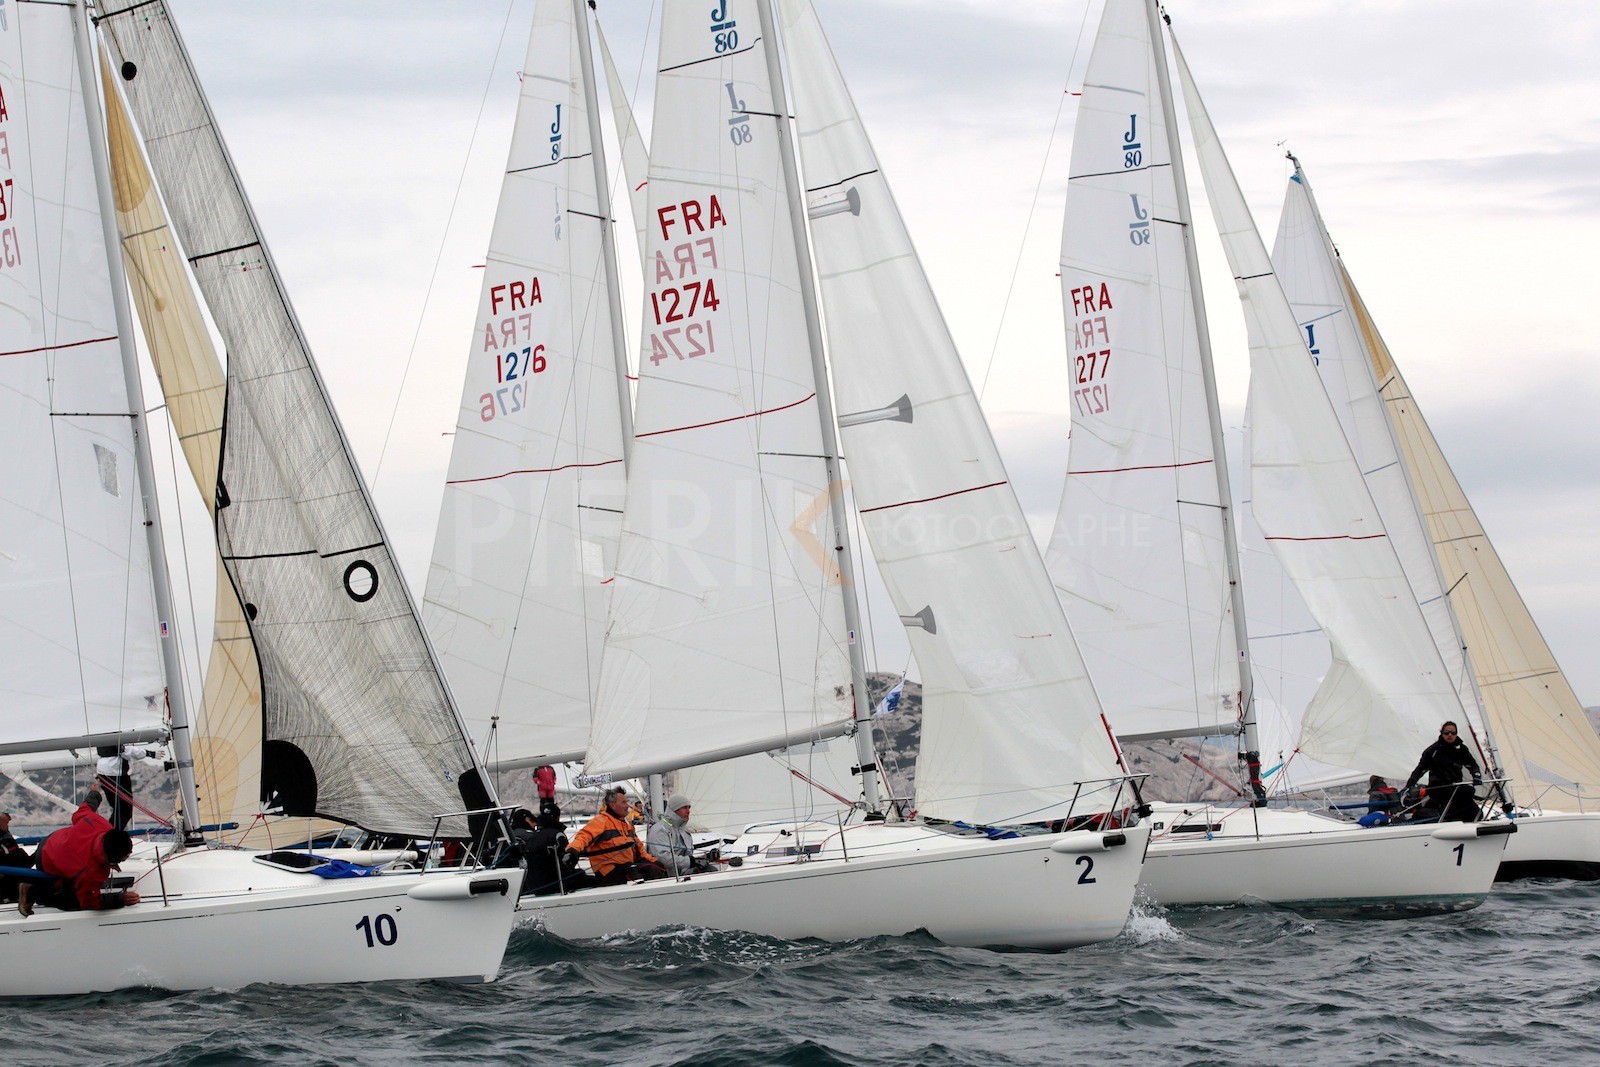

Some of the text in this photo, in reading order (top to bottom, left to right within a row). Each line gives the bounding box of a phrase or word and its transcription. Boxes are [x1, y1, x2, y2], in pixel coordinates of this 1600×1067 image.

[711, 0, 726, 22] J
[715, 30, 738, 53] 80
[551, 104, 561, 134] J
[1124, 114, 1137, 143] J
[552, 142, 562, 161] 8
[1124, 150, 1142, 168] 80
[657, 194, 727, 241] FRA
[490, 277, 542, 315] FRA
[651, 278, 720, 325] 1274
[1071, 282, 1113, 316] FRA
[497, 344, 546, 383] 1276
[1074, 349, 1111, 384] 1277
[1075, 855, 1096, 884] 2
[1453, 843, 1464, 866] 1
[355, 913, 398, 948] 10
